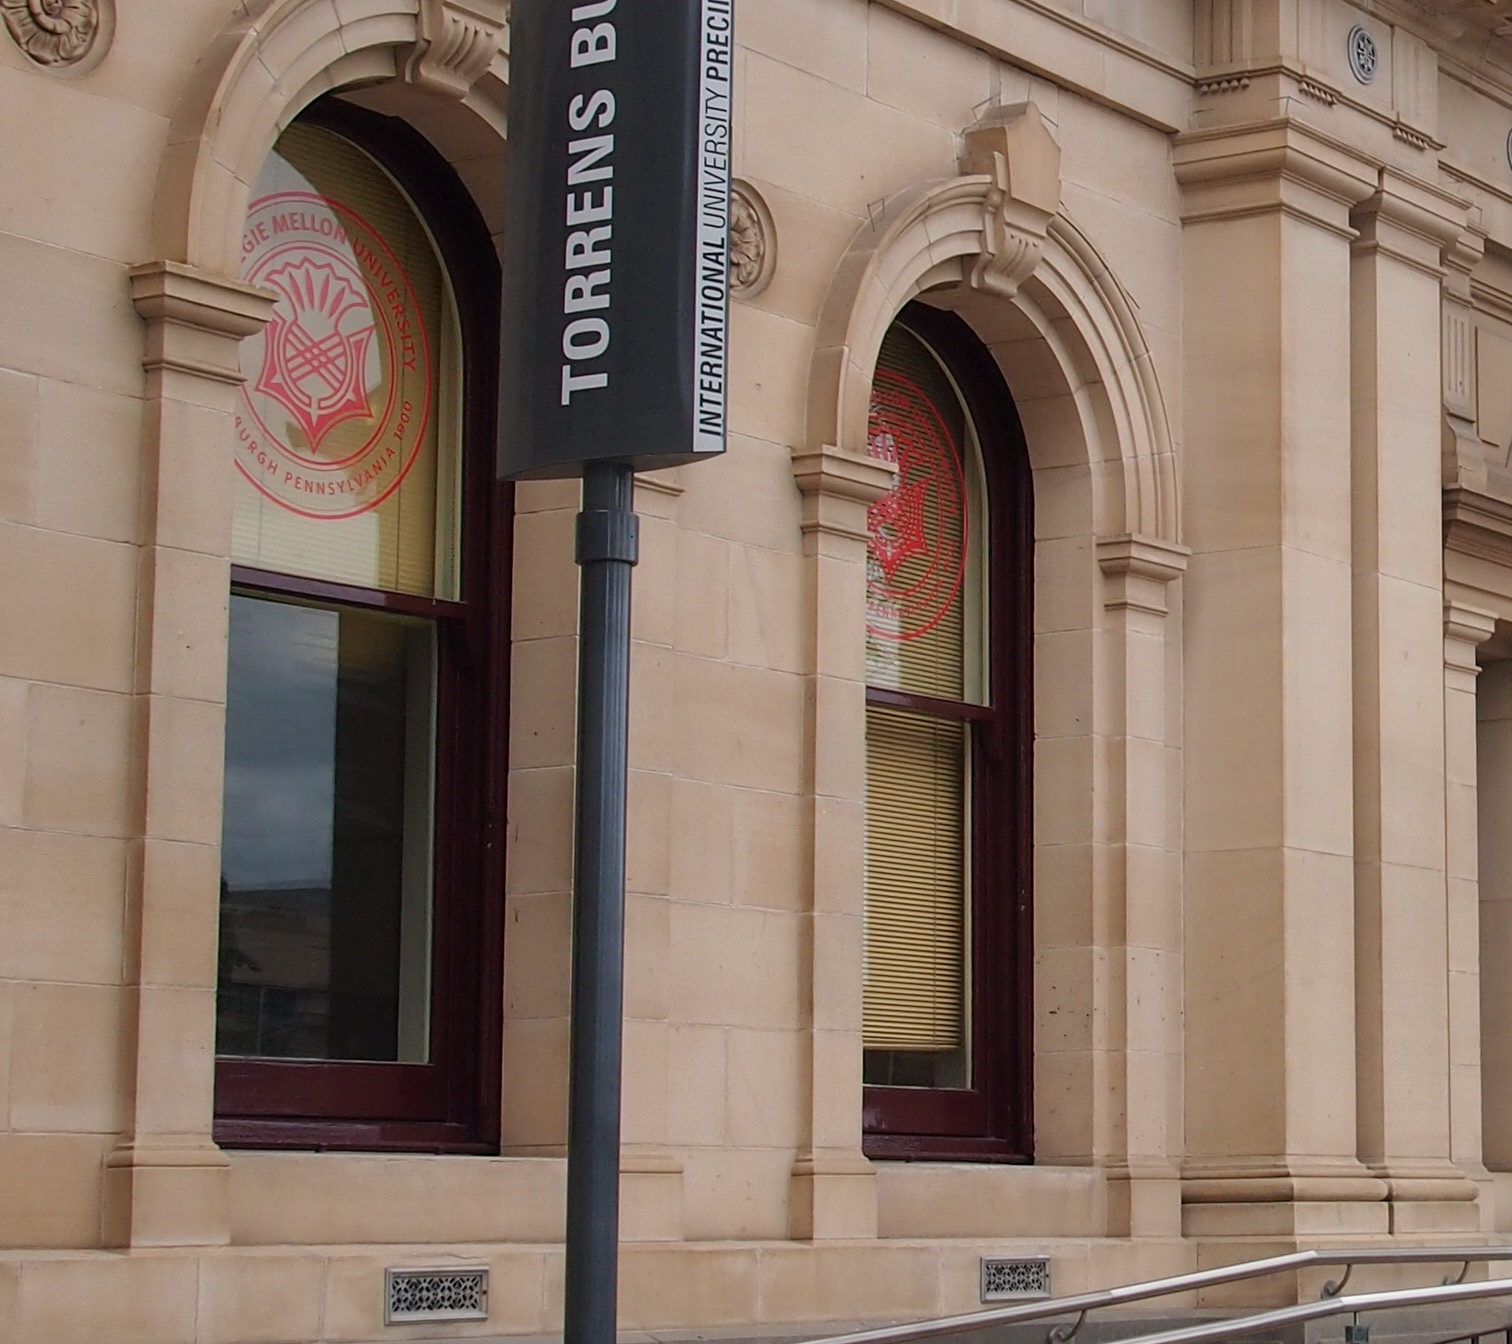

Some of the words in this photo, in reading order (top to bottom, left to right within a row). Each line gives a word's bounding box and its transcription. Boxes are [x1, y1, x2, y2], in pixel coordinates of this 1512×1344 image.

[703, 87, 728, 229] UNIVERSITY
[272, 212, 348, 245] MELLON
[352, 238, 416, 372] UNIVERSITY
[561, 89, 616, 406] TORRENS
[699, 237, 725, 436] INTERNATIONAL
[284, 447, 395, 495] PENNSYLVANIA
[394, 400, 412, 440] 1900
